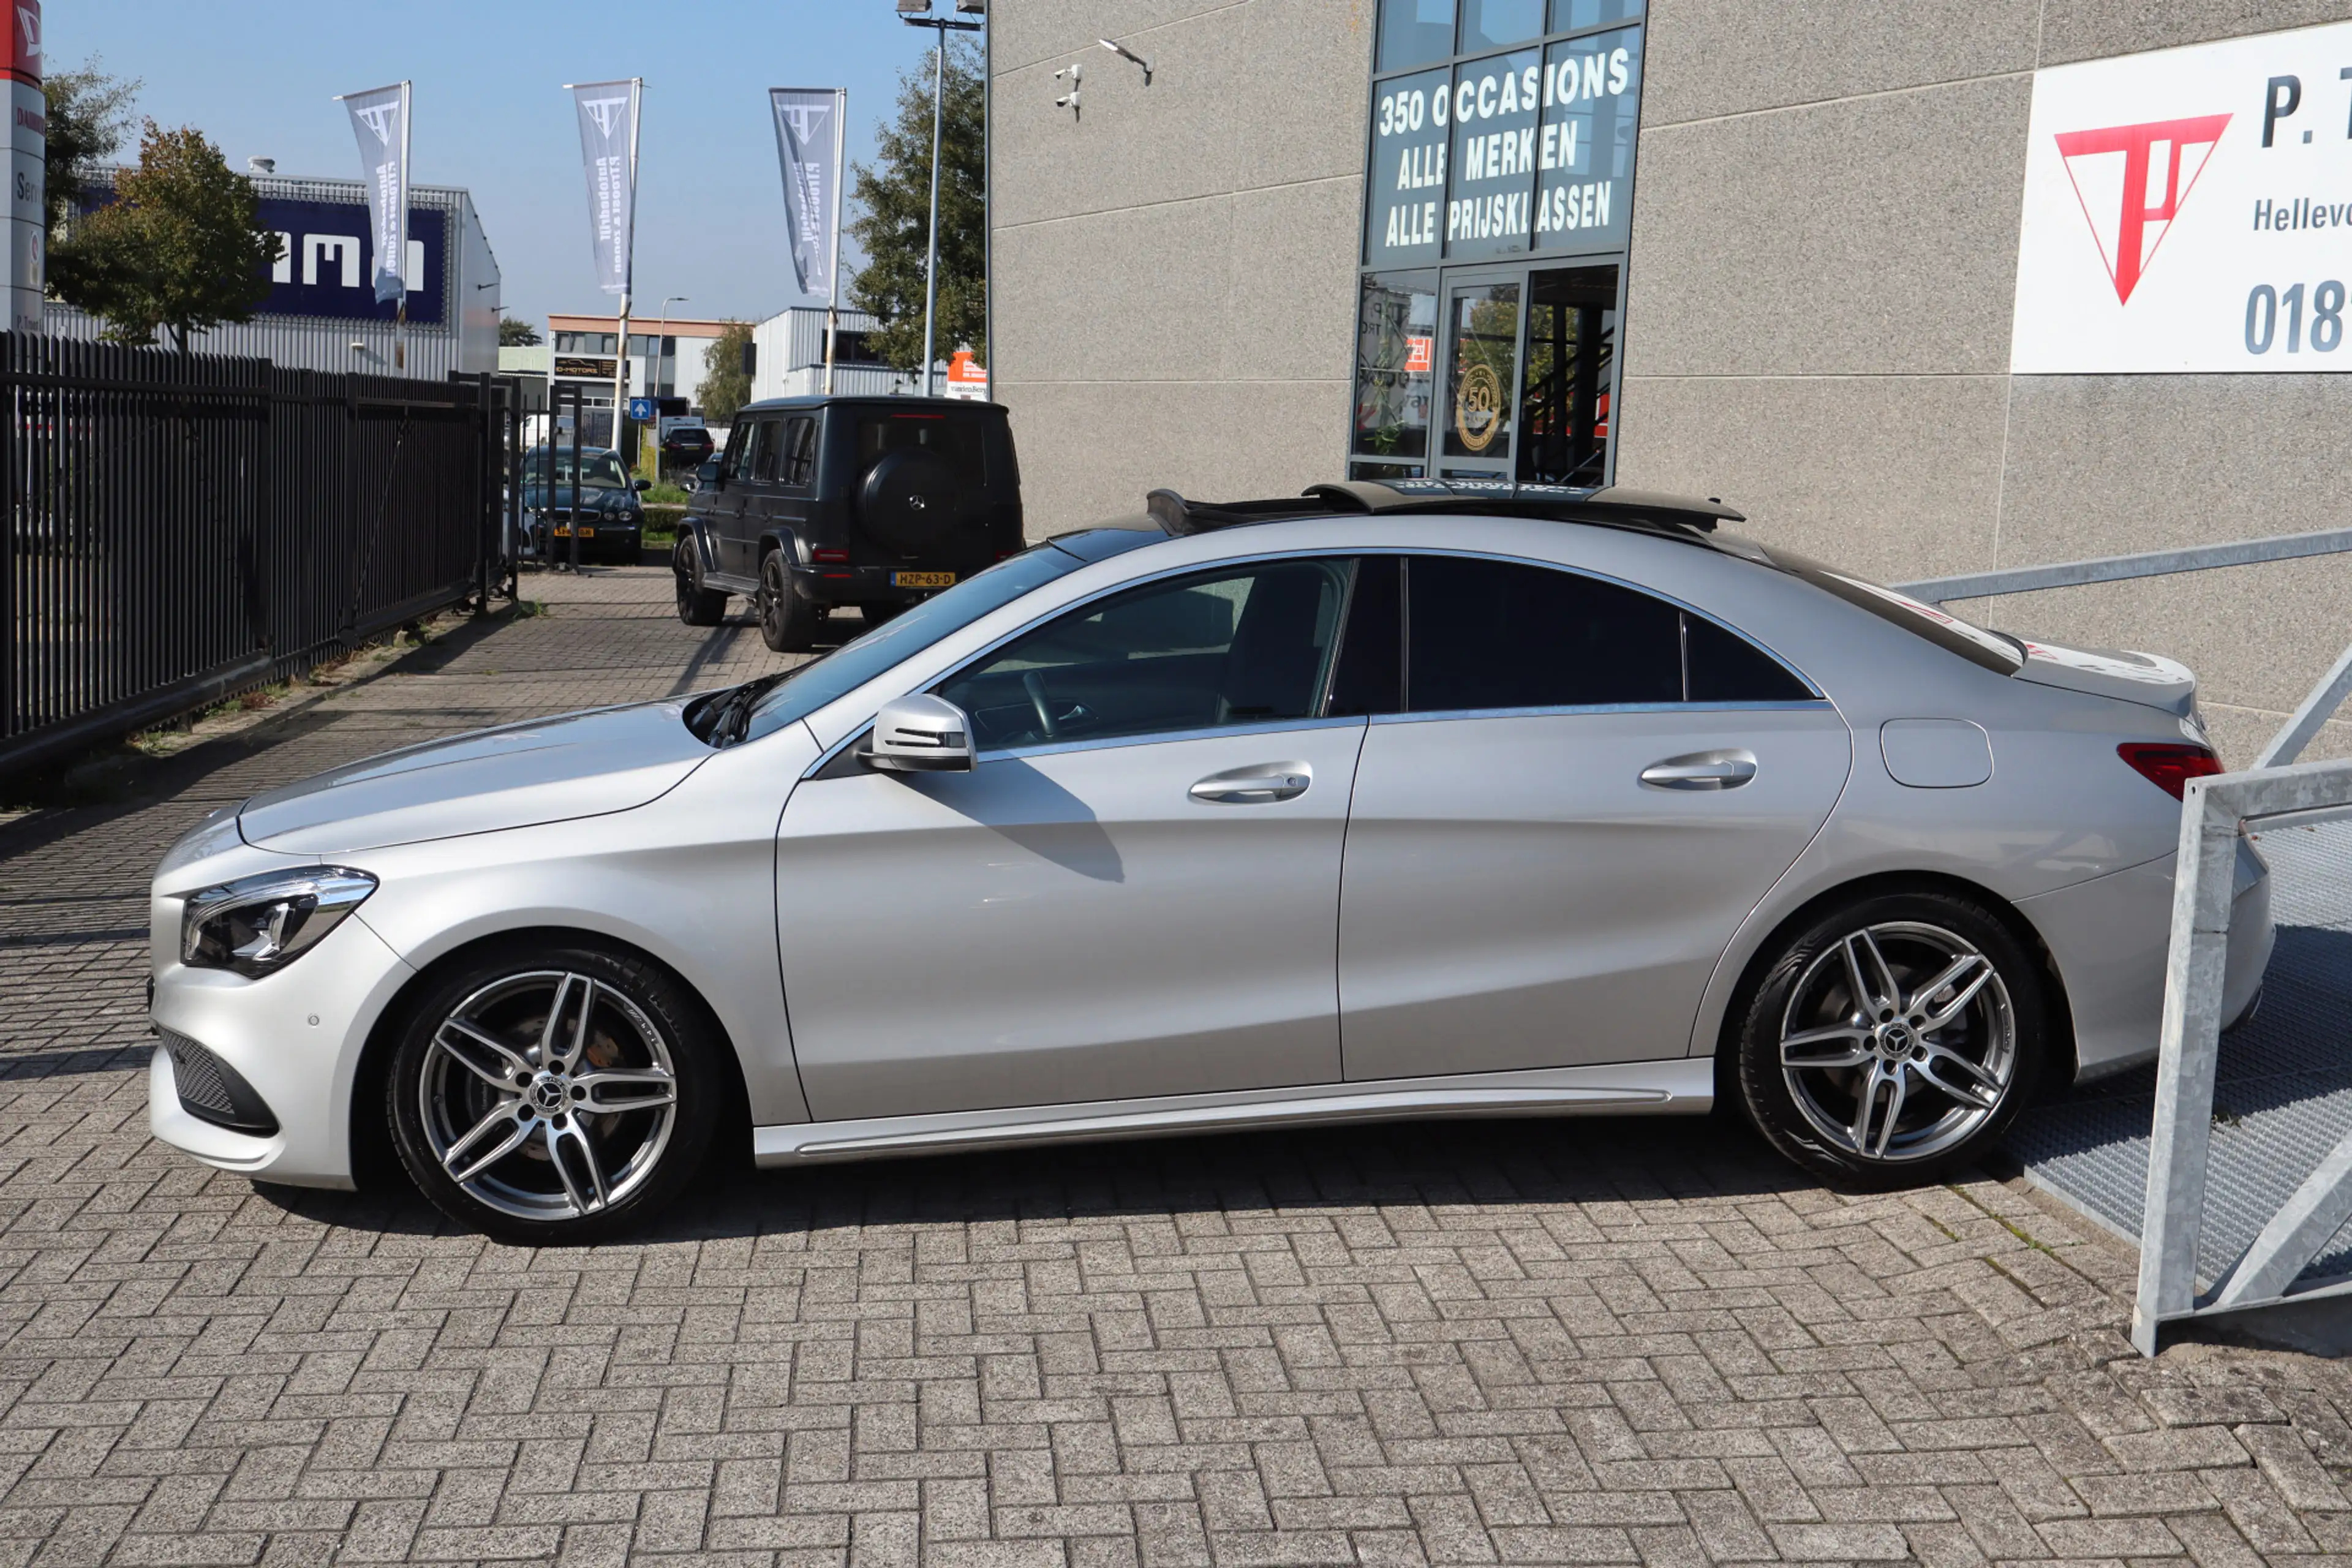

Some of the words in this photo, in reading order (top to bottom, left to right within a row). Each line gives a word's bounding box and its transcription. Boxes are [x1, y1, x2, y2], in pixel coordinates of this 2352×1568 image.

[1380, 90, 1424, 136] 350
[1433, 48, 1629, 126] OCCASIONS
[2261, 74, 2313, 148] P.
[1397, 143, 1445, 190] ALLE
[1465, 121, 1577, 181] MERKEN
[1385, 202, 1436, 247] ALLE
[1448, 181, 1611, 241] PRIJSKLASSEN
[1467, 386, 1490, 412] 50
[900, 573, 951, 584] HZP-63-D
